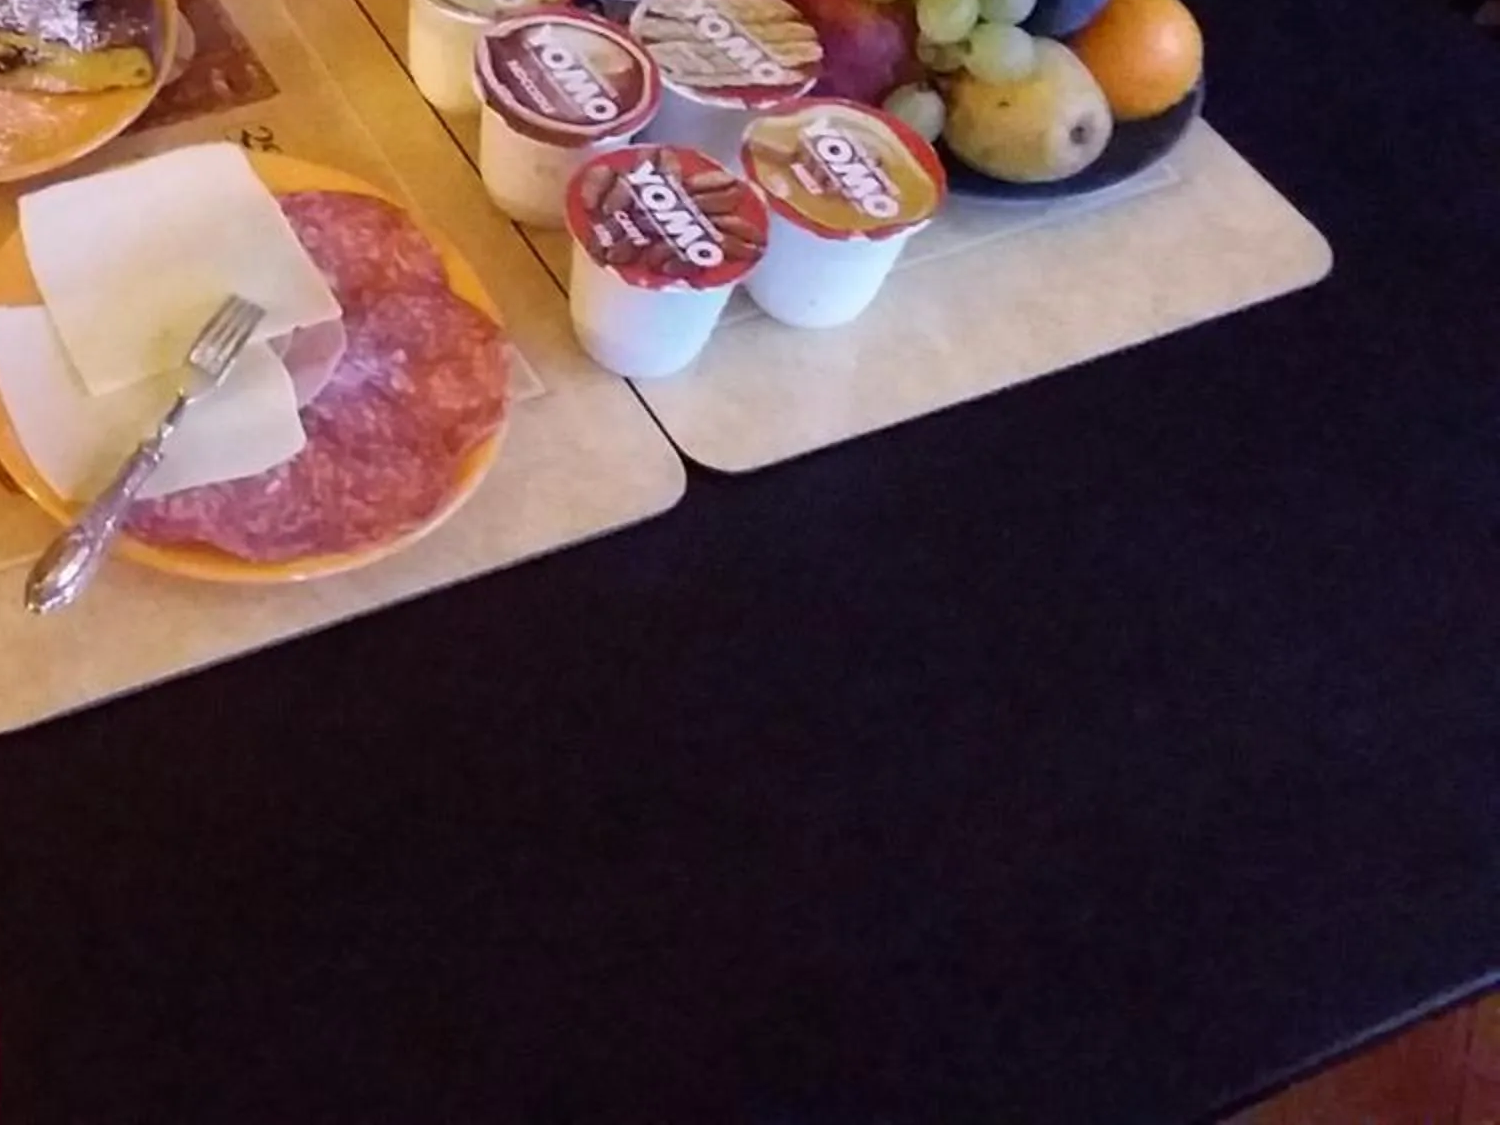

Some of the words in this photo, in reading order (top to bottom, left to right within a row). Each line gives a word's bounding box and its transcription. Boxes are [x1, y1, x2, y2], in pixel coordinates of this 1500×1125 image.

[524, 23, 618, 121] YOMO
[686, 2, 783, 81] YOMO
[627, 160, 724, 267] YOMO
[802, 118, 900, 219] YOMO
